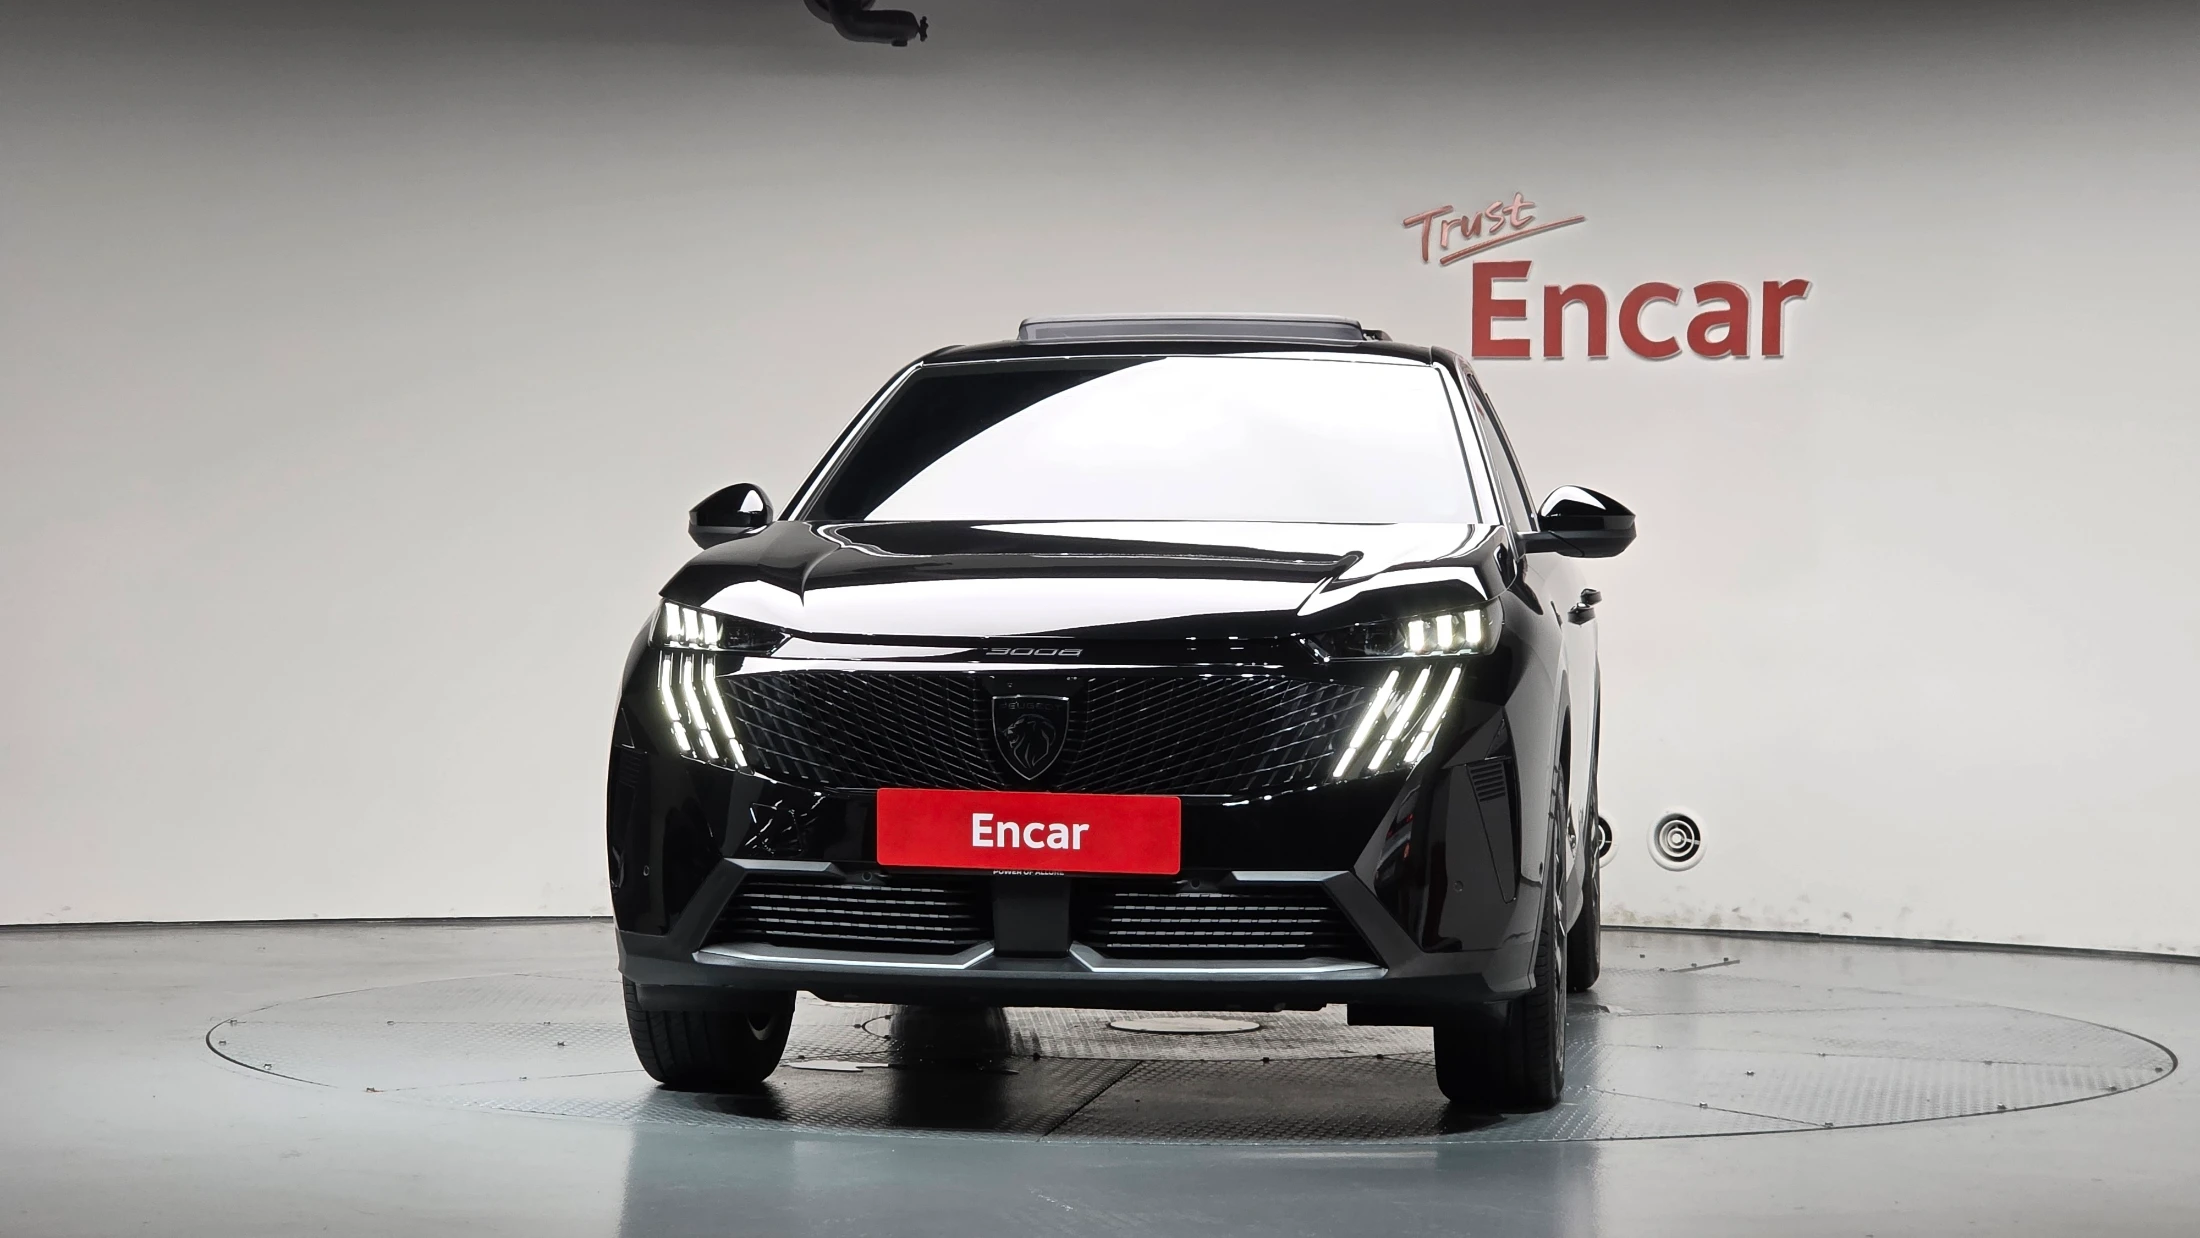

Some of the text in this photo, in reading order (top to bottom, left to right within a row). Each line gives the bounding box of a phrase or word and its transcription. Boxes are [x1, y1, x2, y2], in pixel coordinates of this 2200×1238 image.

[1403, 192, 1535, 262] Trust
[1471, 260, 1812, 359] Encar
[985, 647, 1083, 657] 3008
[999, 702, 1063, 711] PEUGEOT
[971, 812, 1090, 850] Encar
